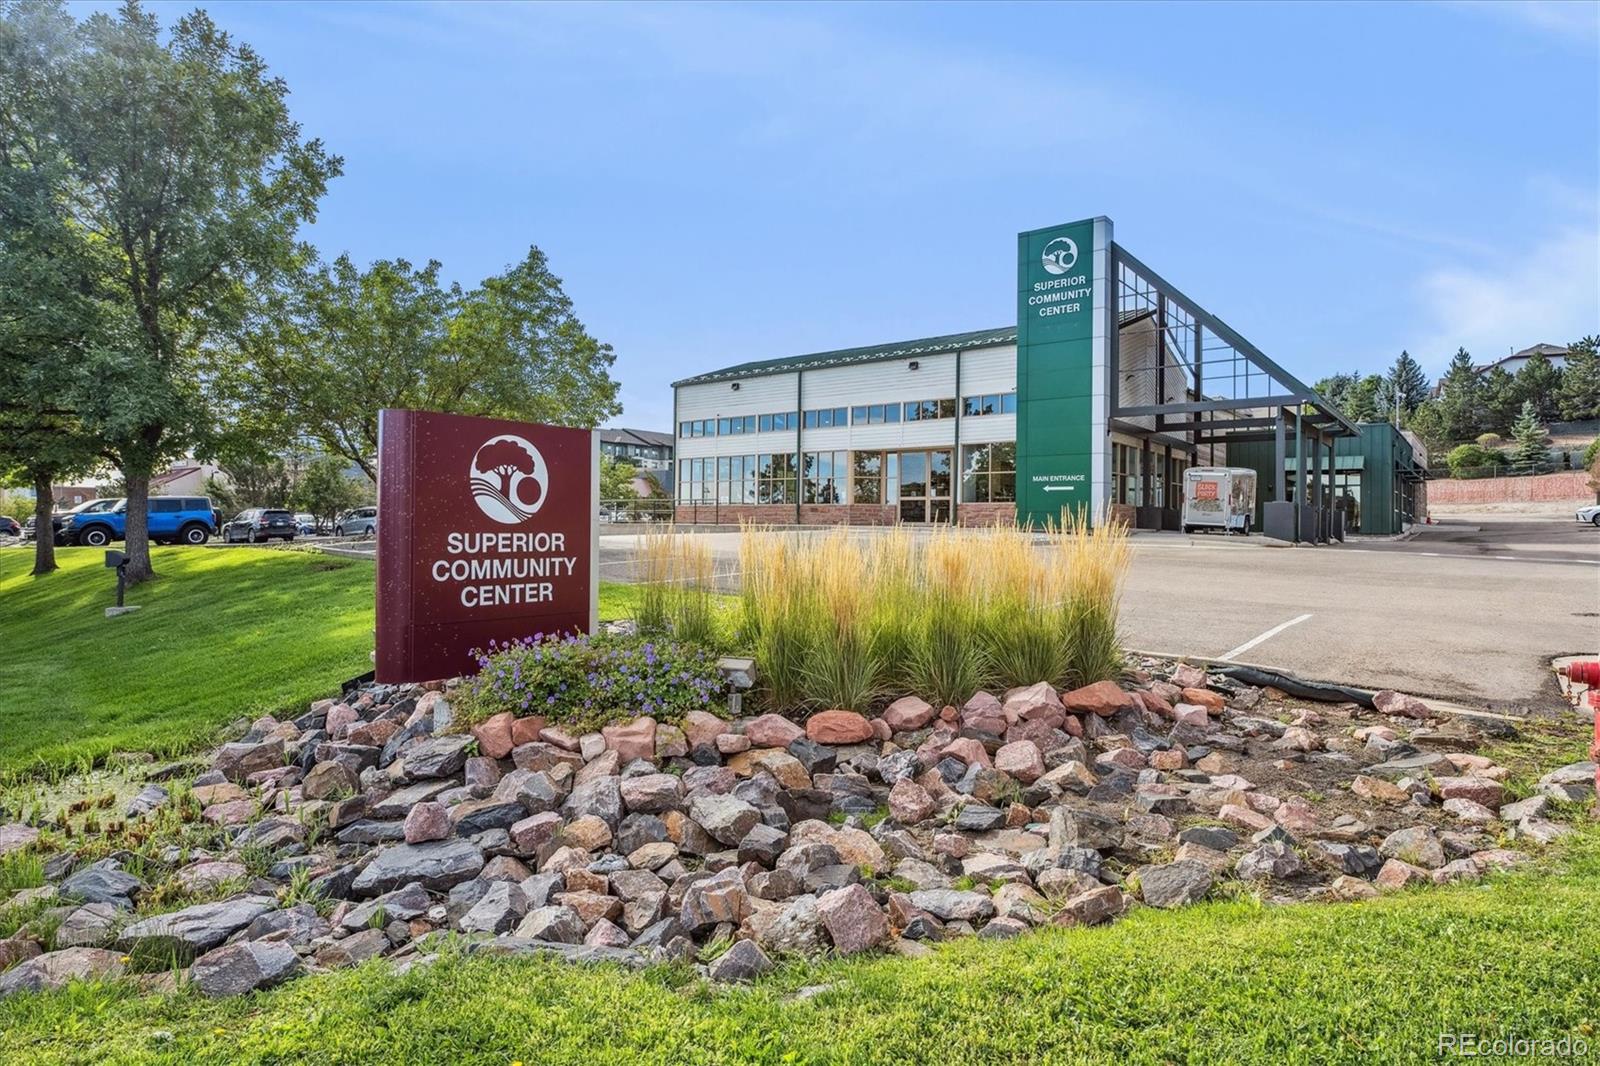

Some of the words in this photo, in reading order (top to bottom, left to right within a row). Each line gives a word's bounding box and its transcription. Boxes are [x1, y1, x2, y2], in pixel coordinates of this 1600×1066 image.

[1033, 276, 1086, 292] SUPERIOR
[1028, 288, 1092, 306] COMMUNITY
[1039, 303, 1081, 317] CENTER
[1032, 475, 1049, 483] MAIN
[1049, 474, 1085, 483] ENTRANCE
[447, 533, 565, 553] SUPERIOR
[432, 557, 577, 582] COMMUNITY
[461, 584, 553, 607] CENTER
